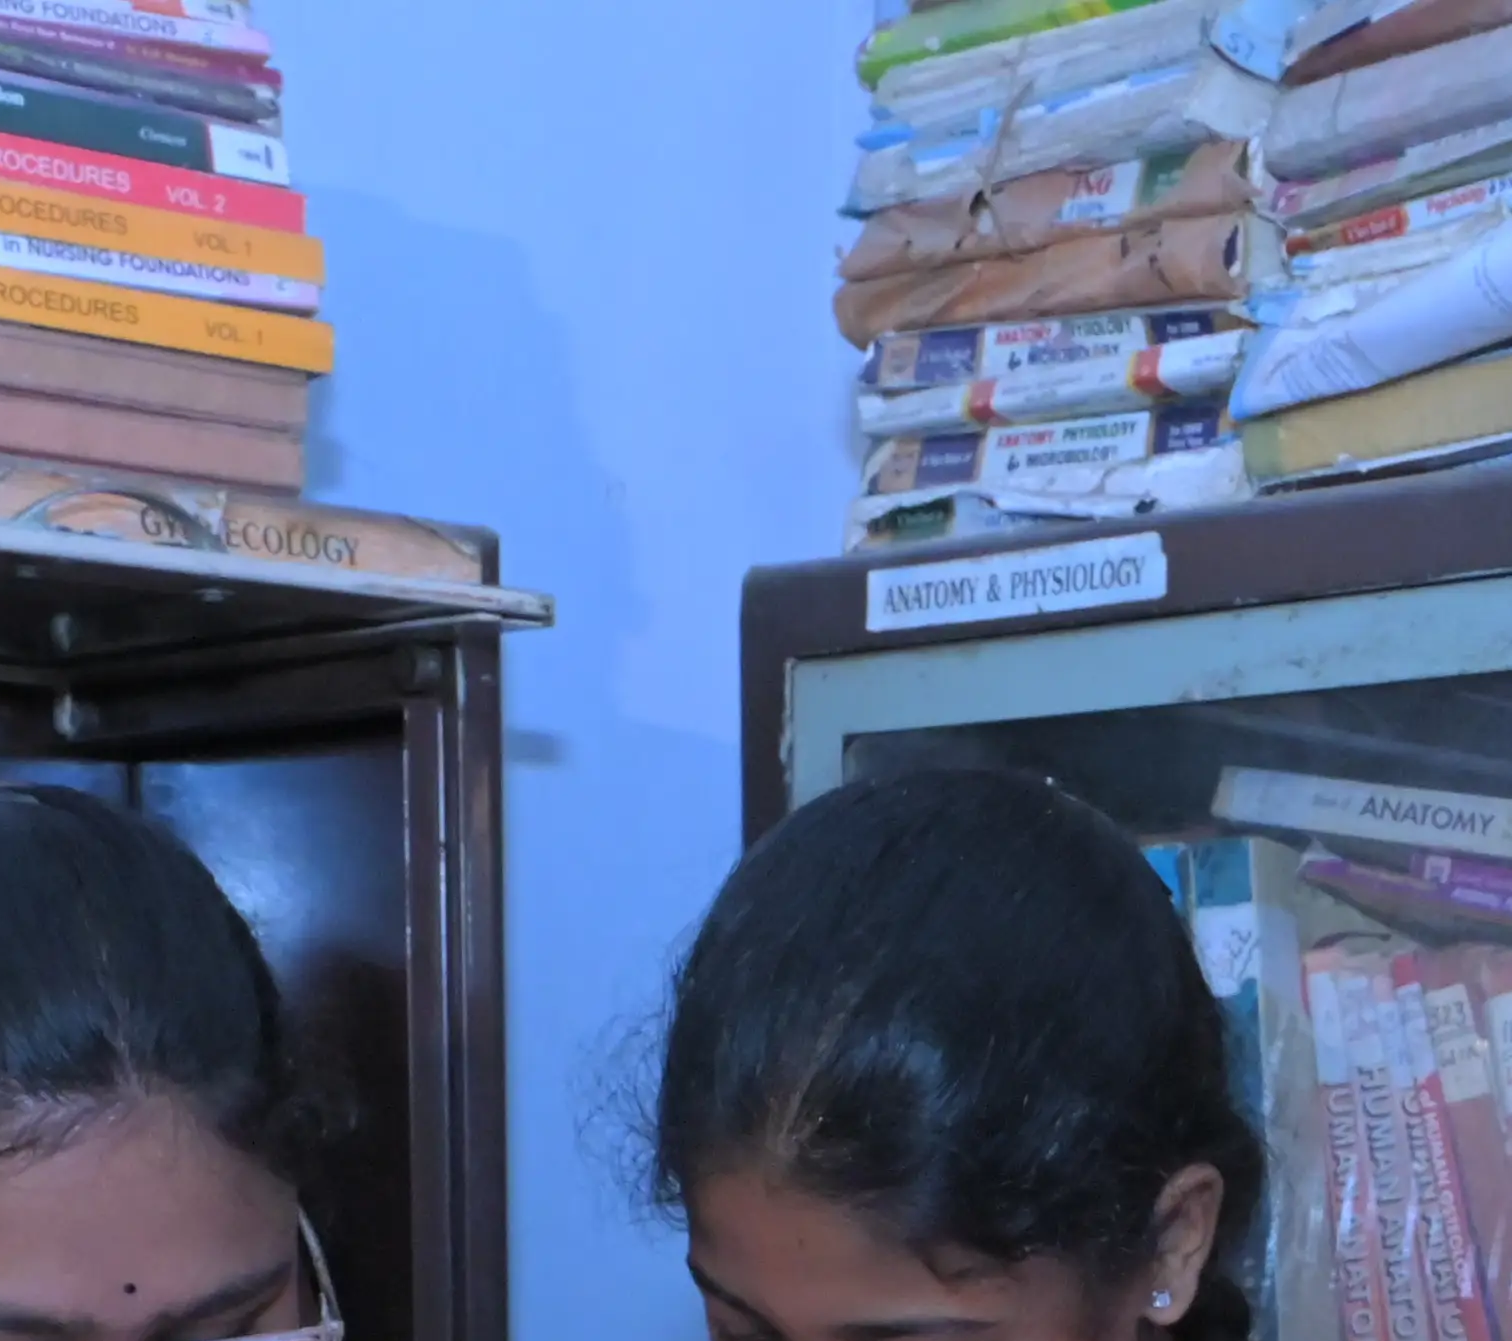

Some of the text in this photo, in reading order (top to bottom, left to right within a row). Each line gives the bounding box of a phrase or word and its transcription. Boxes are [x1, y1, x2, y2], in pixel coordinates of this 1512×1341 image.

[165, 185, 208, 210] VOL
[214, 194, 226, 214] 2
[2, 234, 21, 252] in
[27, 238, 114, 267] NURSING
[119, 254, 251, 287] FOUNDATIONS
[193, 231, 235, 256] VOL
[244, 241, 252, 257] 1
[204, 318, 247, 344] VOL
[256, 329, 264, 346] 1
[140, 505, 361, 567] GYECOLOGY
[883, 555, 1145, 615] ANATOMY & PHYSIOLOGY
[1359, 795, 1496, 837] ANATOMY
